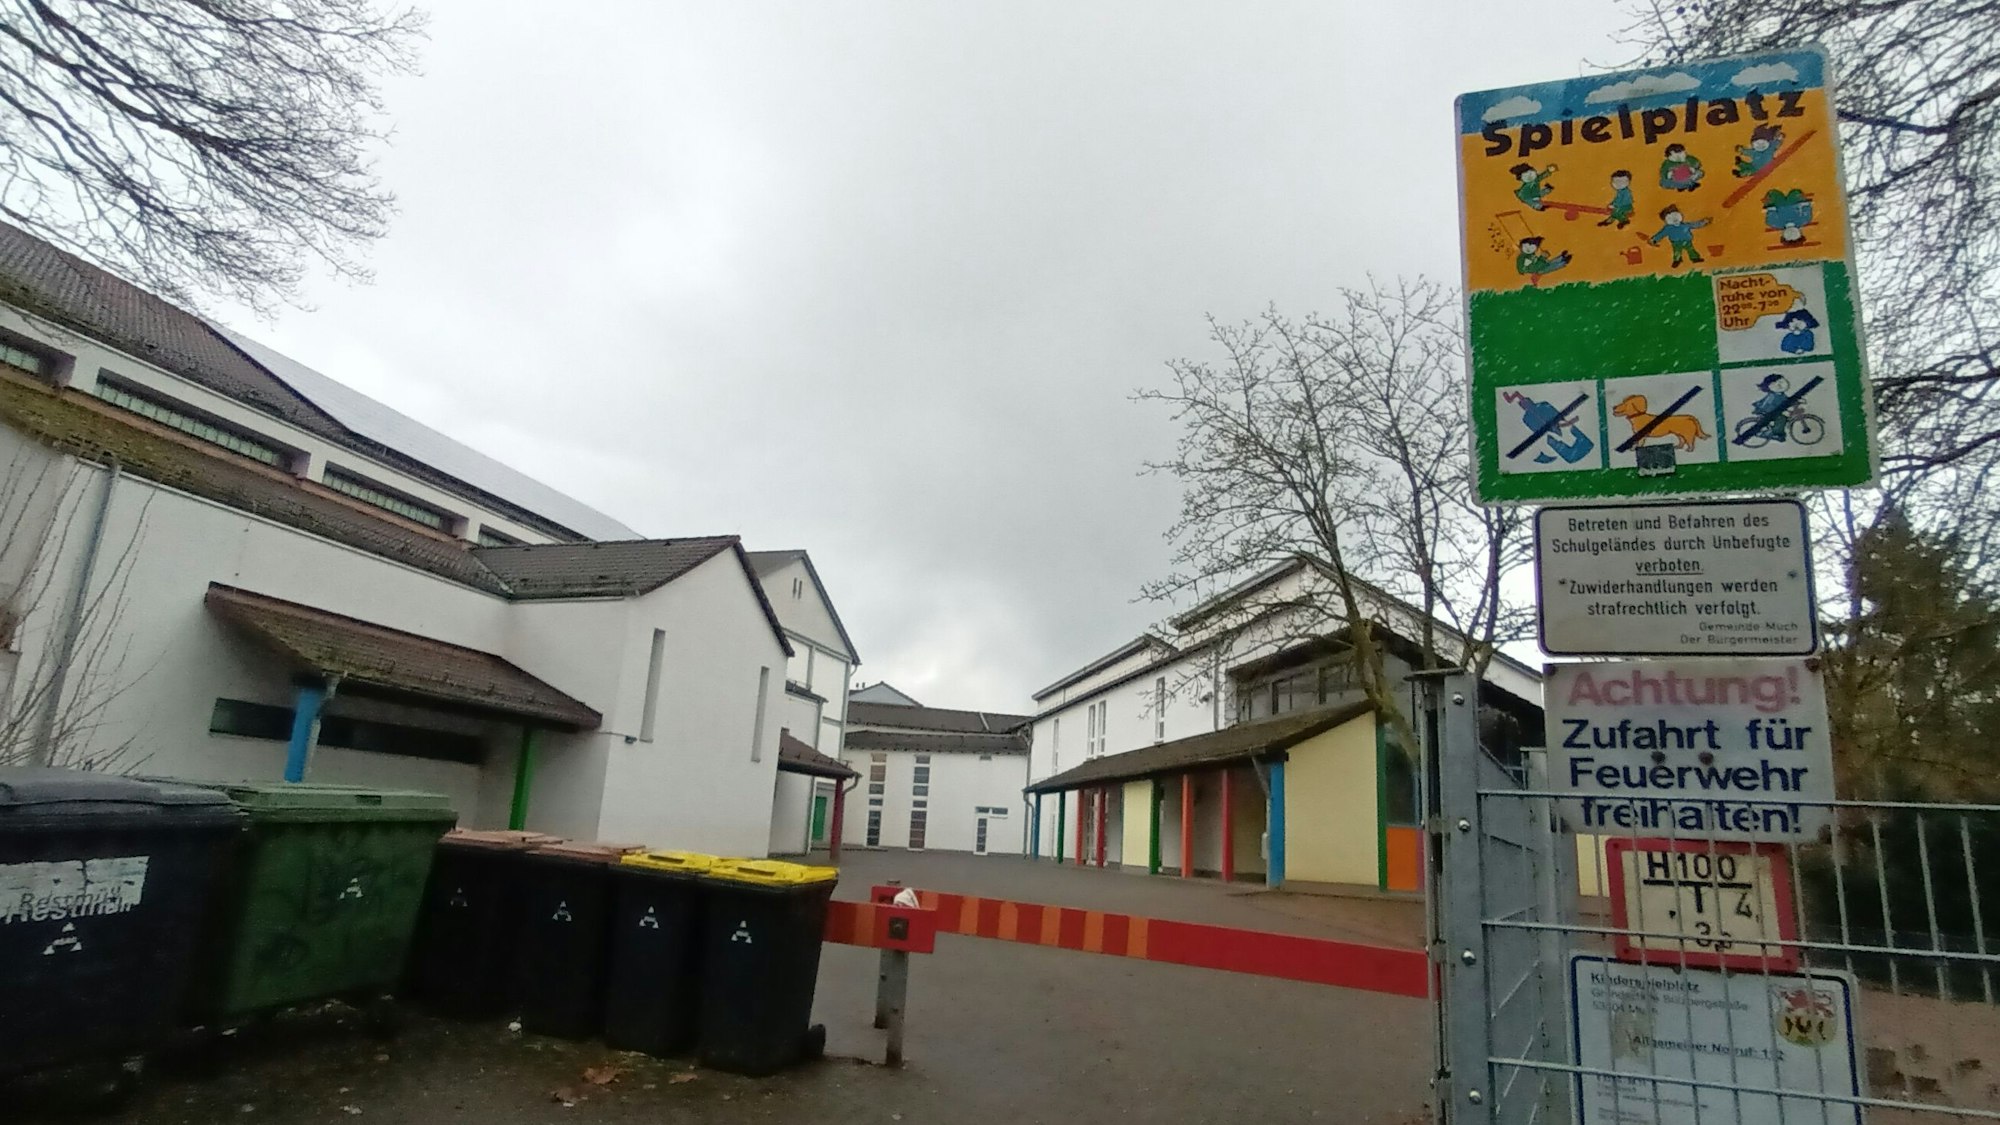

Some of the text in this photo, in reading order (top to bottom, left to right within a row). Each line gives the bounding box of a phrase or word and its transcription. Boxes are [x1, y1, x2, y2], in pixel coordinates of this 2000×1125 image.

[1481, 91, 1805, 157] Spielplatz
[1720, 277, 1770, 290] Nacht-
[1721, 288, 1787, 302] ruhe von
[1724, 316, 1749, 327] Uhr
[1568, 513, 1769, 532] Betreten und Befahren des
[1552, 535, 1791, 556] Schulgeländes durch Unbefugte
[1635, 558, 1704, 573] verboten.
[1569, 578, 1778, 597] Zuwiderhandlungen werden
[1587, 601, 1760, 619] strafrechtlich verfolgt.
[1700, 621, 1798, 632] Gemeinde Much
[1680, 634, 1700, 645] Der
[1568, 667, 1801, 713] Achtung!
[1562, 718, 1812, 750] Zufahrt für
[1570, 757, 1808, 792] Feuerwehr
[1581, 798, 1801, 834] freihaten!
